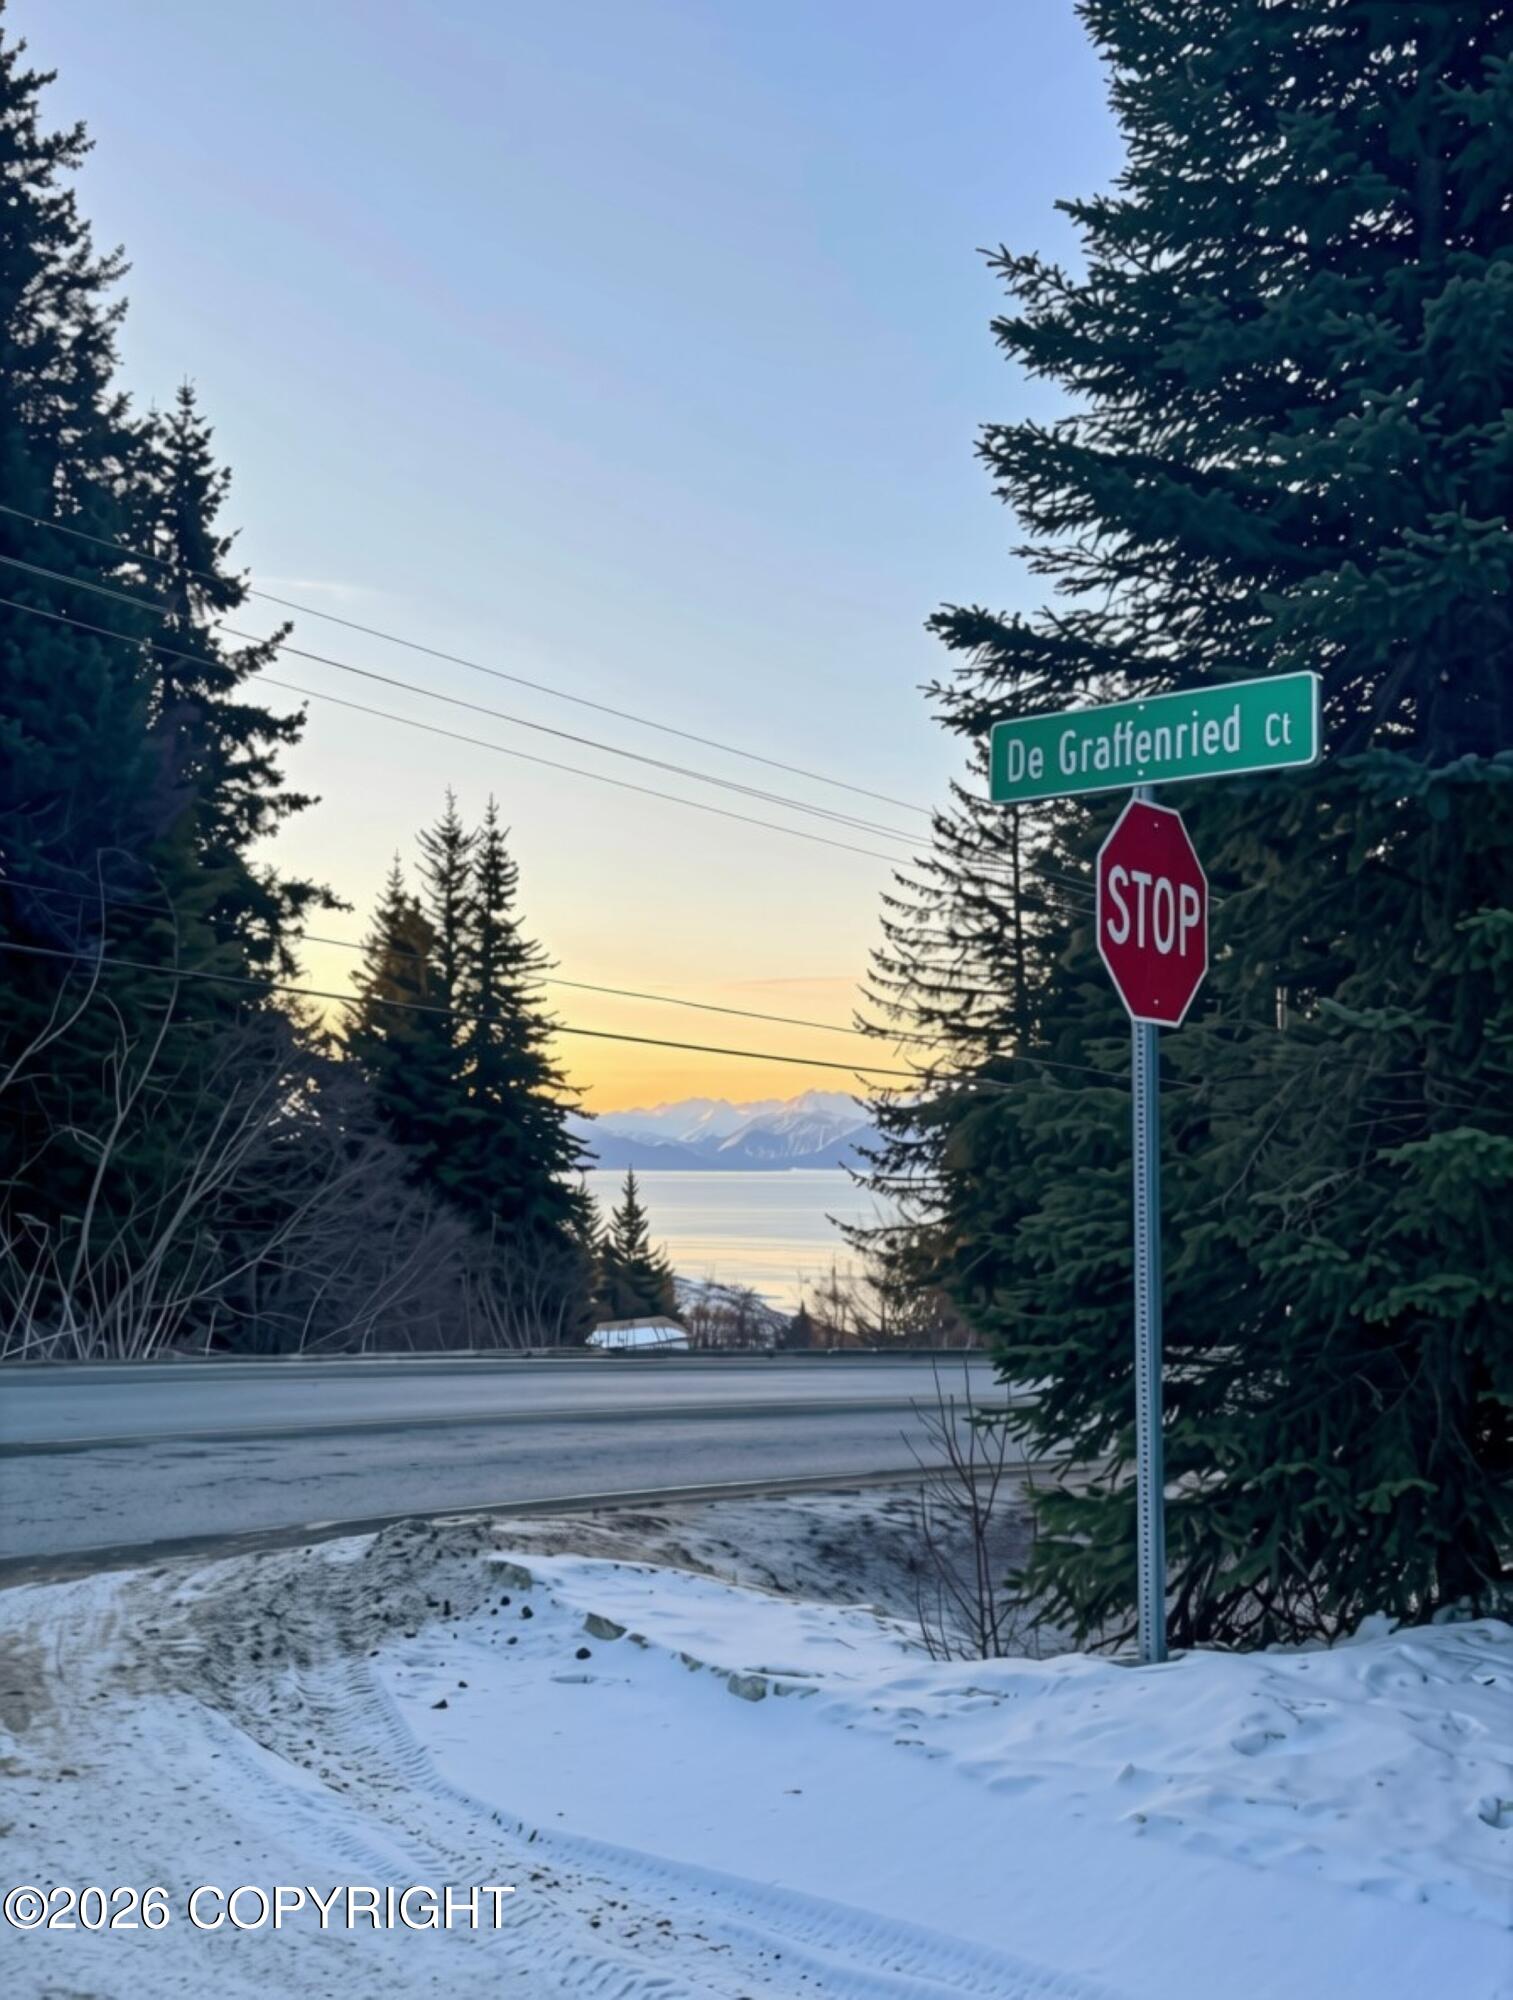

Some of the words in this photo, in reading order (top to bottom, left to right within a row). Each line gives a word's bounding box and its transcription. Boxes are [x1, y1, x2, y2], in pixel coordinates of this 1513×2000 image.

[1007, 738, 1044, 783] De
[1058, 703, 1241, 776] Graffenried
[1265, 712, 1292, 747] Ct
[1106, 864, 1201, 957] STOP
